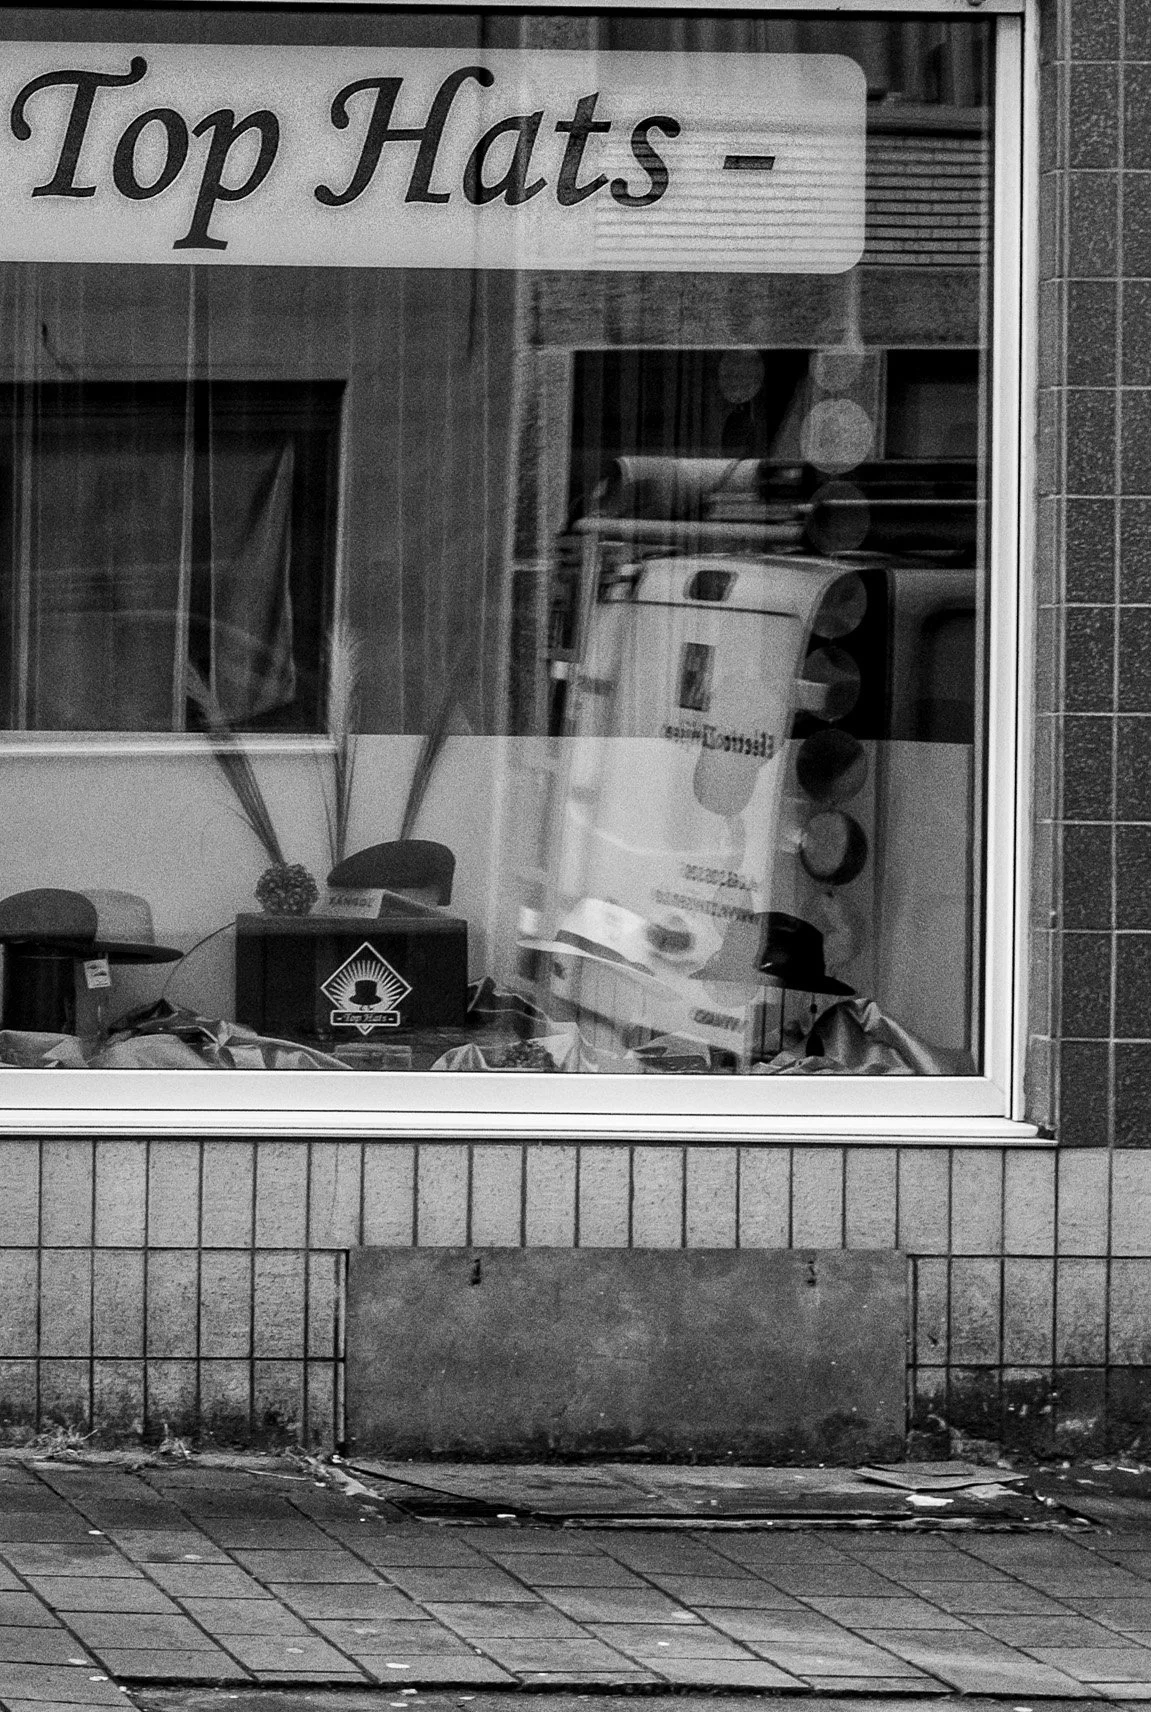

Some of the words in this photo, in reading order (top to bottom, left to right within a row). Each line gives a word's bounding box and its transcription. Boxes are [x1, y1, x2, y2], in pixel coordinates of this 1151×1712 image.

[10, 55, 281, 250] Top
[313, 65, 681, 206] Hats
[343, 1012, 363, 1024] Top
[363, 1012, 388, 1023] Hats
